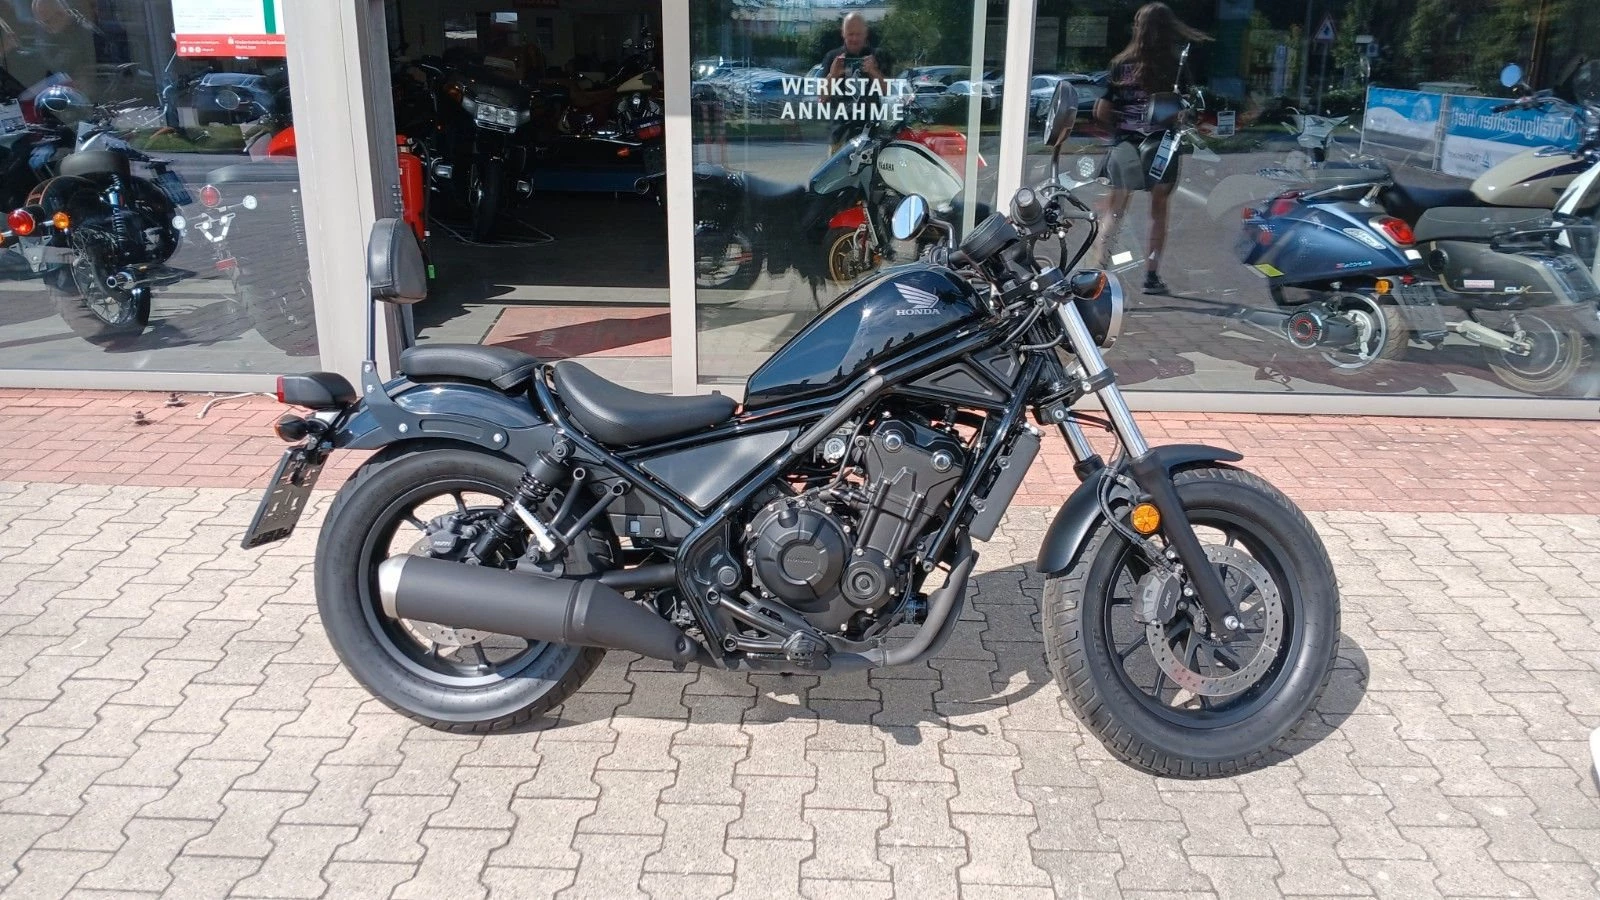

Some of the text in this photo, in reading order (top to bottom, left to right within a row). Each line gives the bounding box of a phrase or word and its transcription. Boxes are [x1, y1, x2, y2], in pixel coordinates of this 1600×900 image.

[781, 78, 908, 97] WERKSTATT
[781, 102, 904, 121] ANNAHME
[896, 308, 941, 316] HONDA
